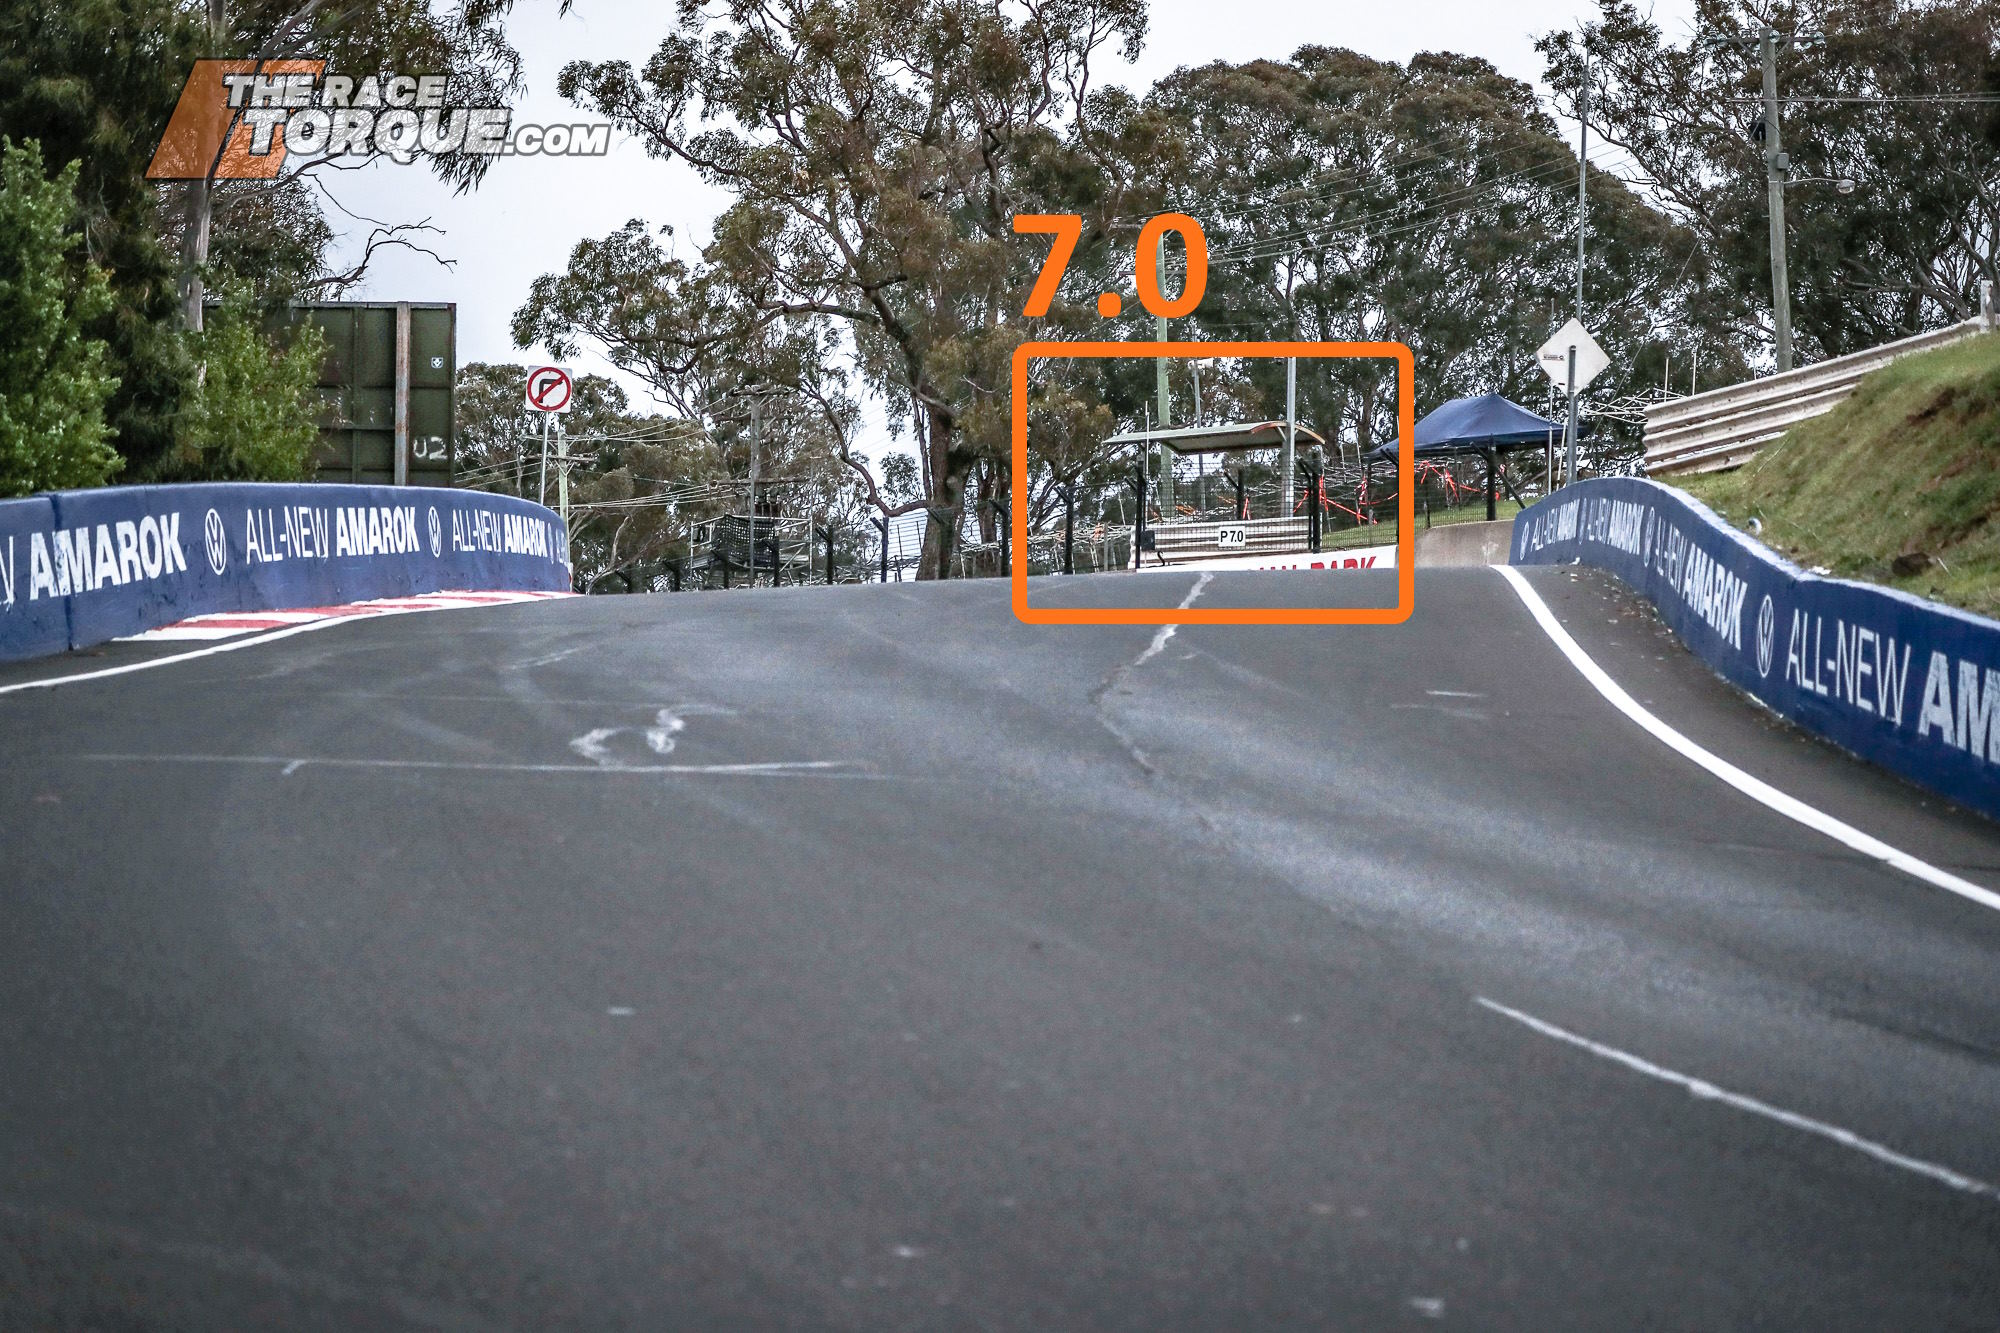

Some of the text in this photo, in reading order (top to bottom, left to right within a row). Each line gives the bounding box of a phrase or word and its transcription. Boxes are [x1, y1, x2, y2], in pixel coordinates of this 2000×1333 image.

[29, 511, 187, 601] AMAROK
[246, 505, 420, 565] ALL-NEW AMAROK
[452, 508, 502, 552] ALL-NEW
[503, 513, 548, 558] AMAROK
[1682, 542, 1748, 650] AMAROK
[1786, 608, 1911, 727] ALL-NEW
